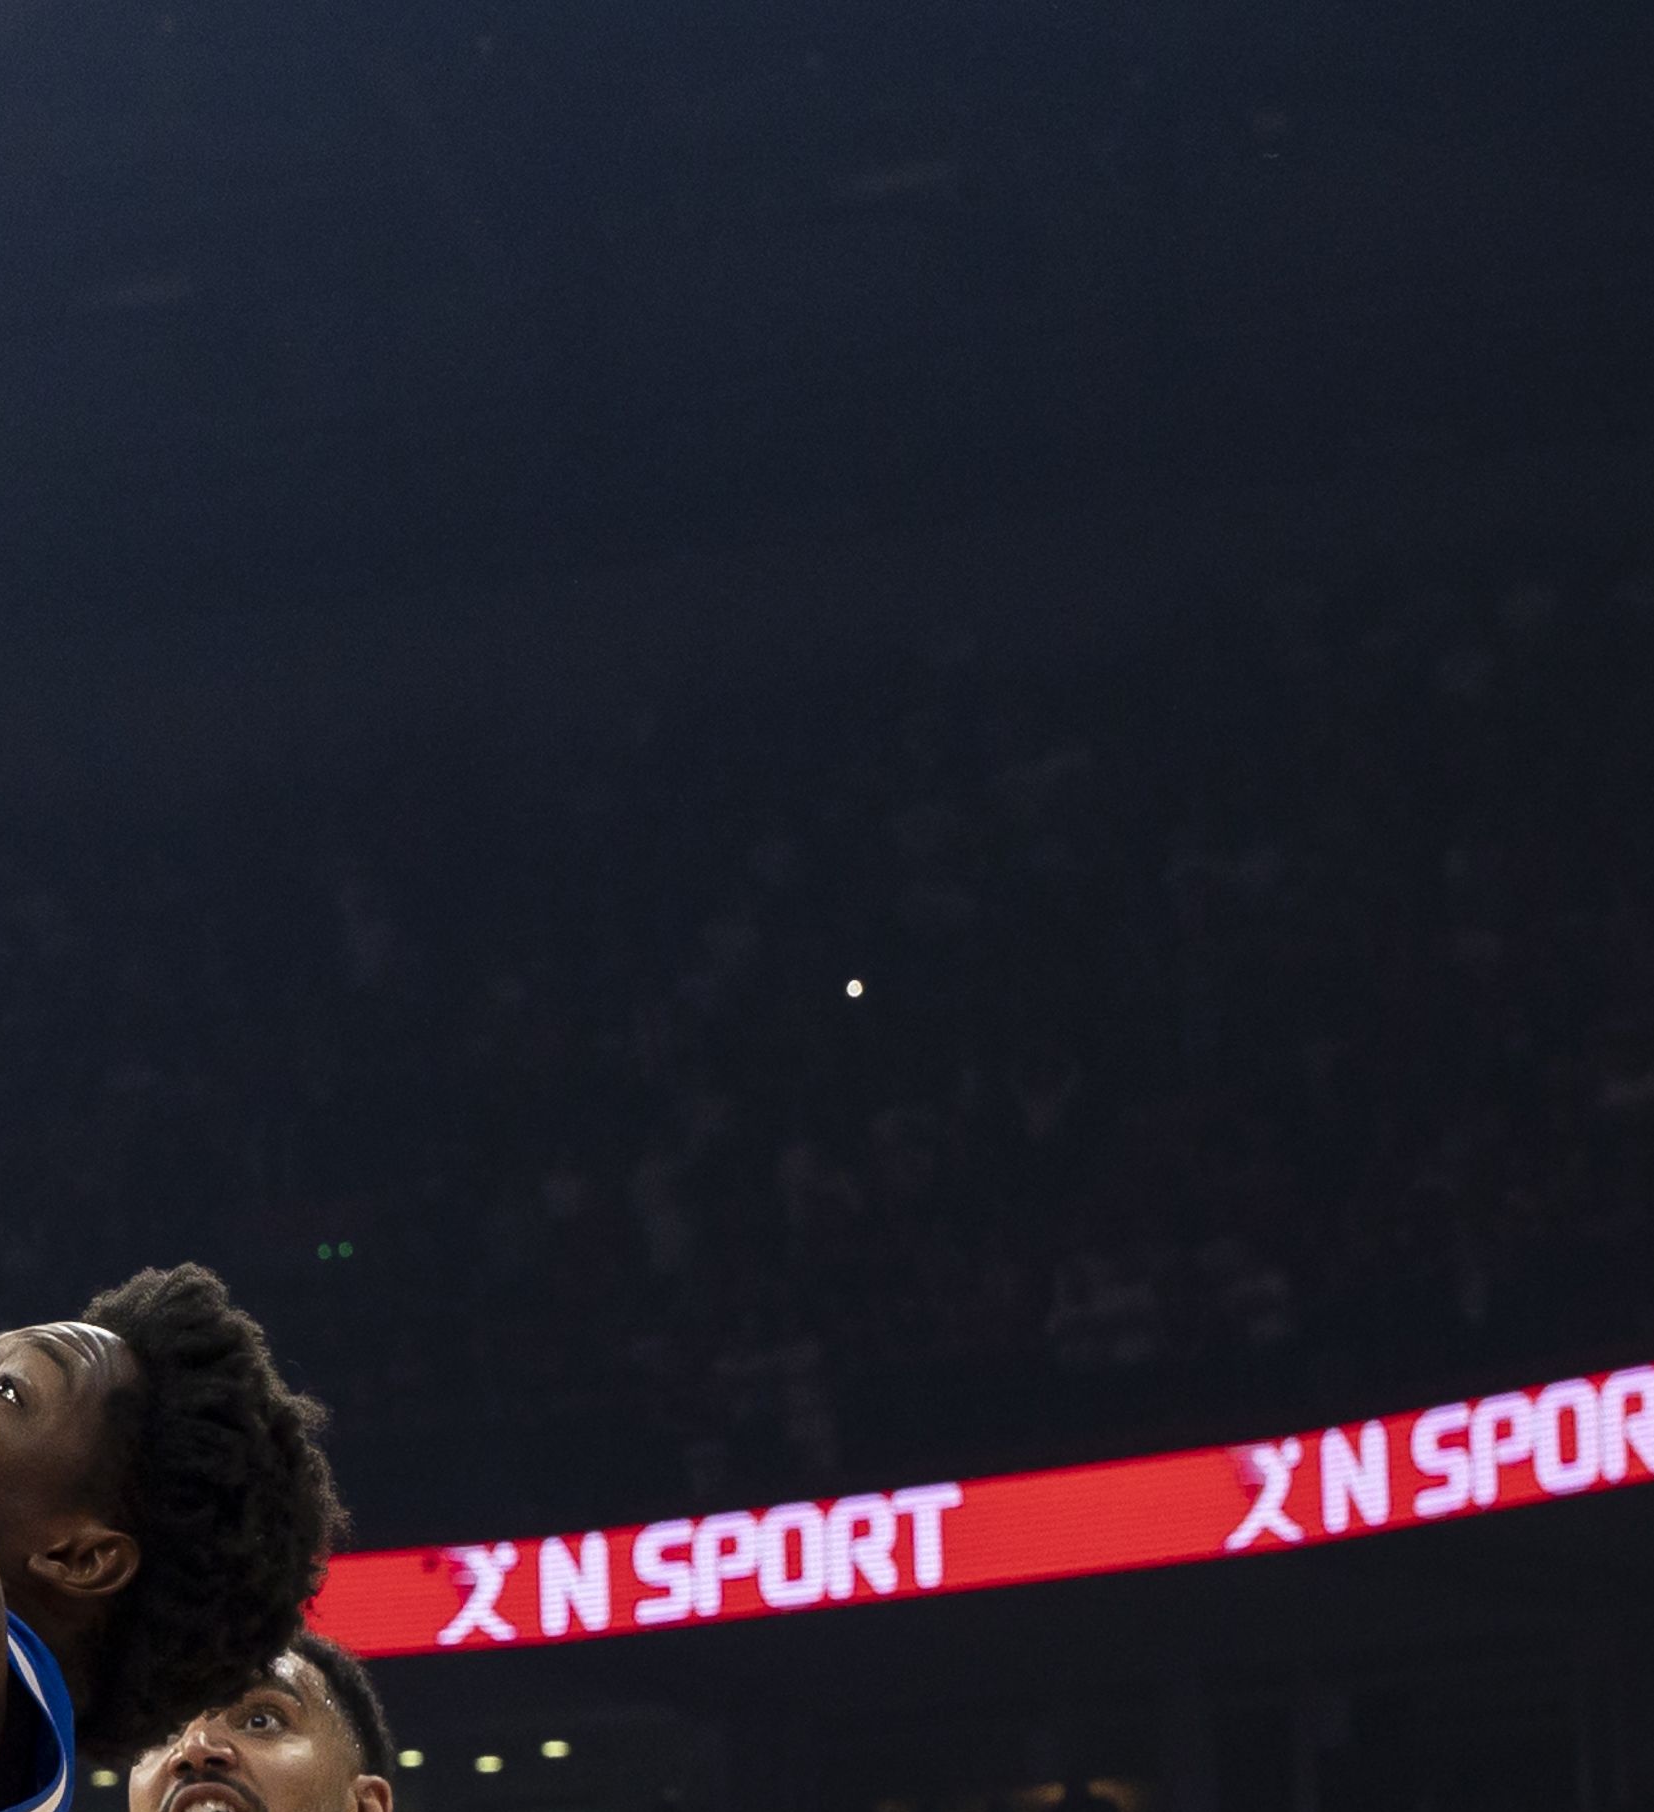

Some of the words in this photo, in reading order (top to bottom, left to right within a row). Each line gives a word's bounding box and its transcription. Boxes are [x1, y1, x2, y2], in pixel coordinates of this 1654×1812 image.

[1319, 1419, 1391, 1534] N
[1410, 1364, 1654, 1519] SPOR
[538, 1530, 611, 1637] N
[632, 1481, 964, 1626] SPORT
